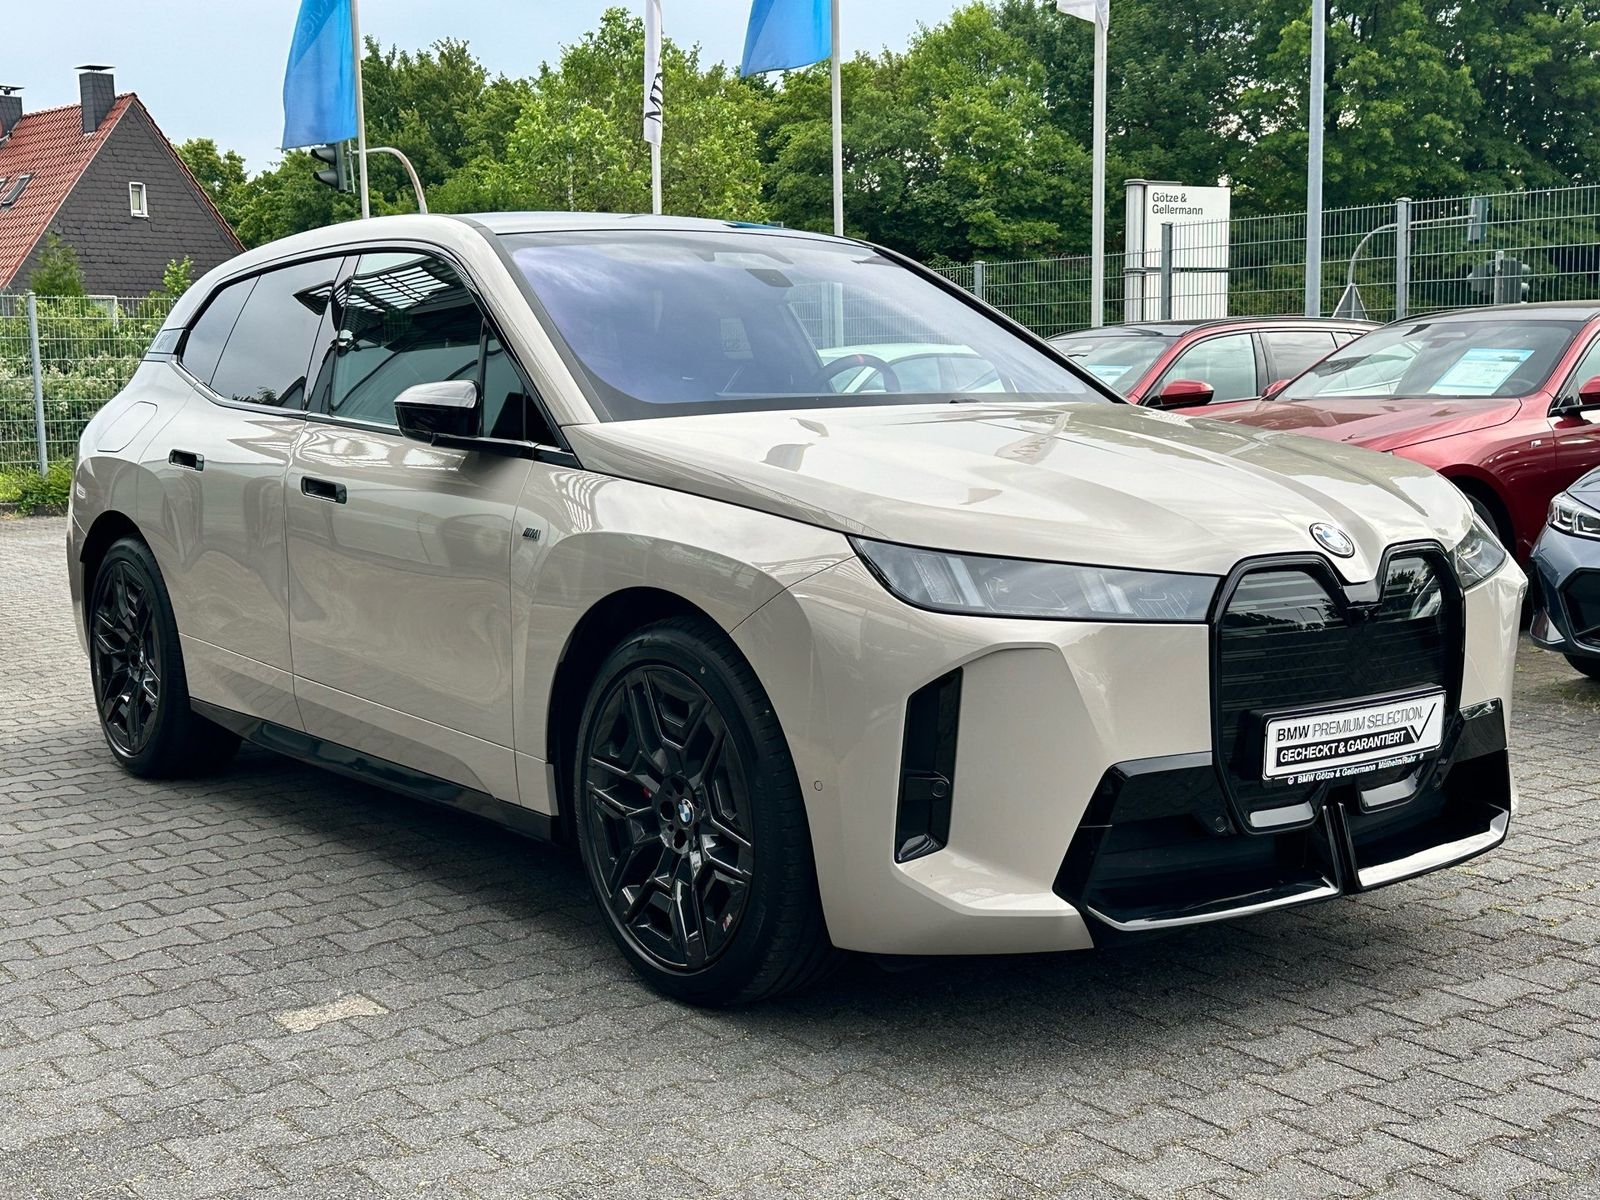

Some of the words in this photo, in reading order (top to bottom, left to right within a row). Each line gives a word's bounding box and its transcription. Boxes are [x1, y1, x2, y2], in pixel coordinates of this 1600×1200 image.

[1152, 192, 1179, 202] Götze
[1181, 192, 1187, 203] &
[1152, 204, 1203, 215] Gellermann
[1277, 724, 1310, 742] BMW
[1312, 716, 1366, 738] PREMIUM
[1280, 742, 1338, 763] GECHECKT
[1338, 741, 1346, 754] &
[1347, 730, 1407, 752] GARANTIERT
[1297, 773, 1315, 784] BMW
[1335, 769, 1341, 778] &
